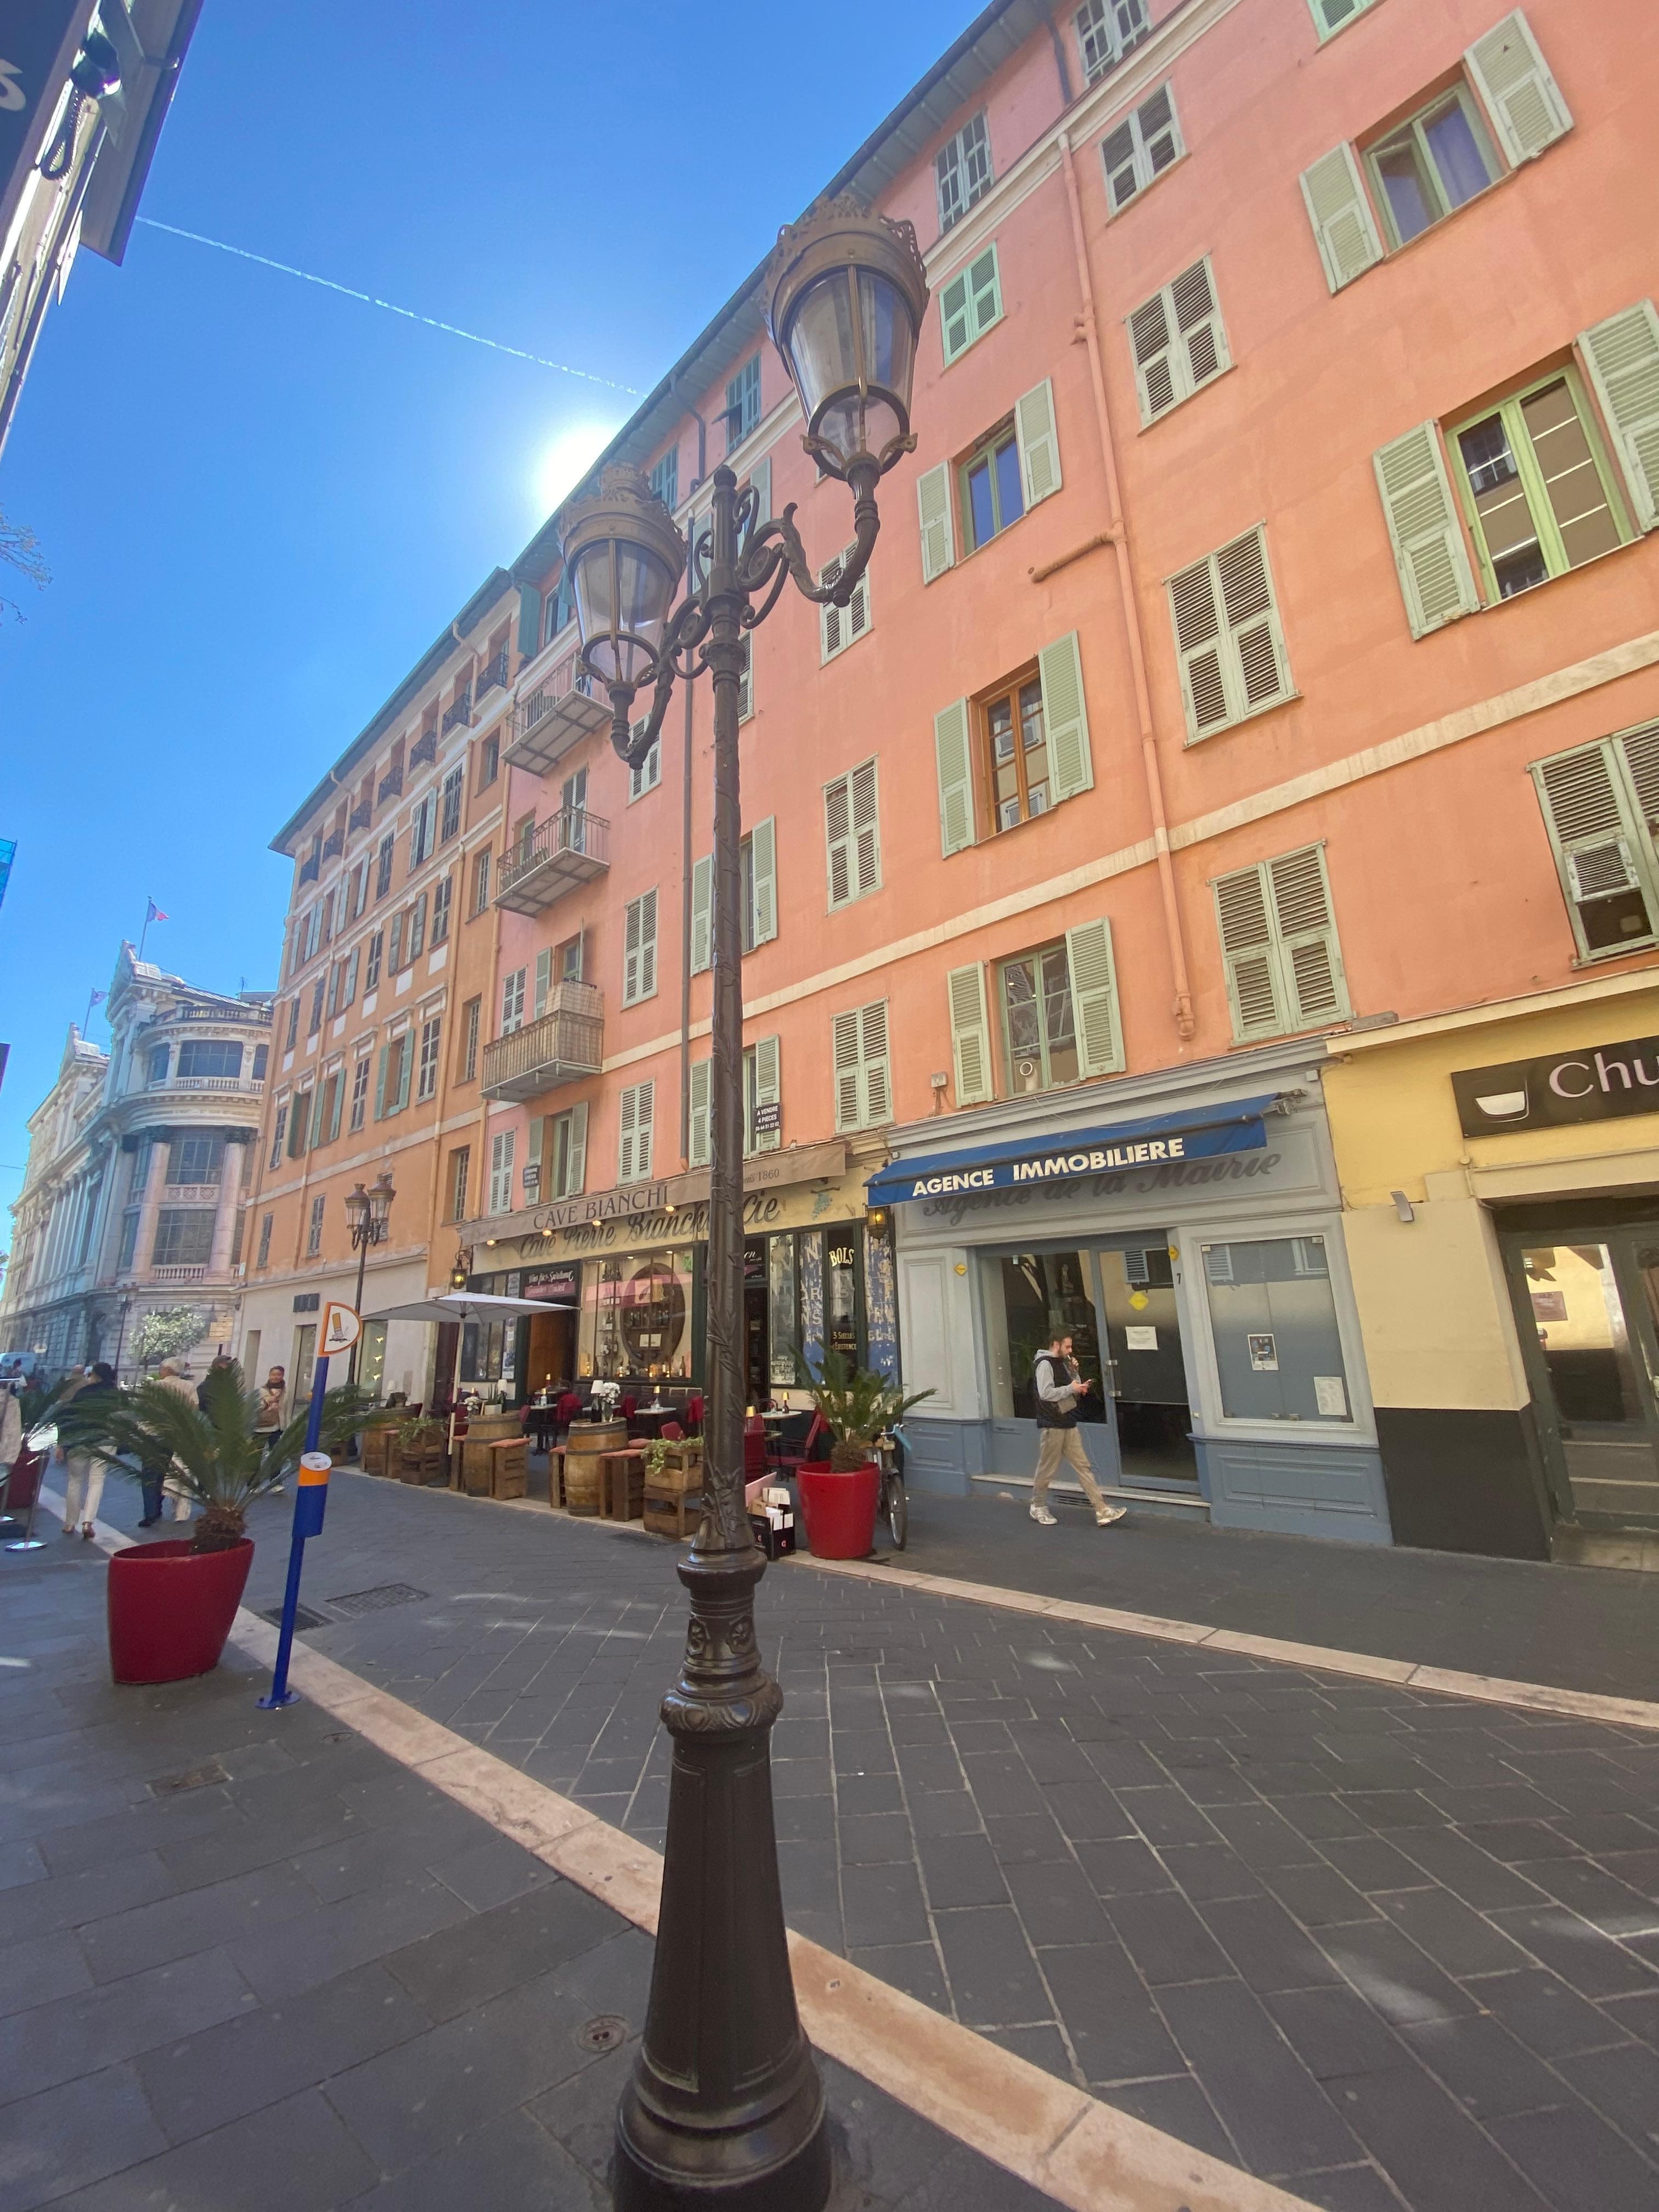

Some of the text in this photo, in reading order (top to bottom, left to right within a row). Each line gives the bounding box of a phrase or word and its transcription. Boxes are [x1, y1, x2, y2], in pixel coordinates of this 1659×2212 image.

[761, 1105, 778, 1114] VENDRE
[761, 1114, 777, 1122] PIECES
[758, 1168, 780, 1181] 1860
[912, 1137, 1185, 1197] AGENCE IMMOBILIERE
[1136, 1153, 1282, 1193] Mairie
[533, 1185, 669, 1229] CAVE BIANCHI
[519, 1234, 557, 1260] Cave
[828, 1246, 855, 1267] BOLS
[1176, 1273, 1181, 1284] 7
